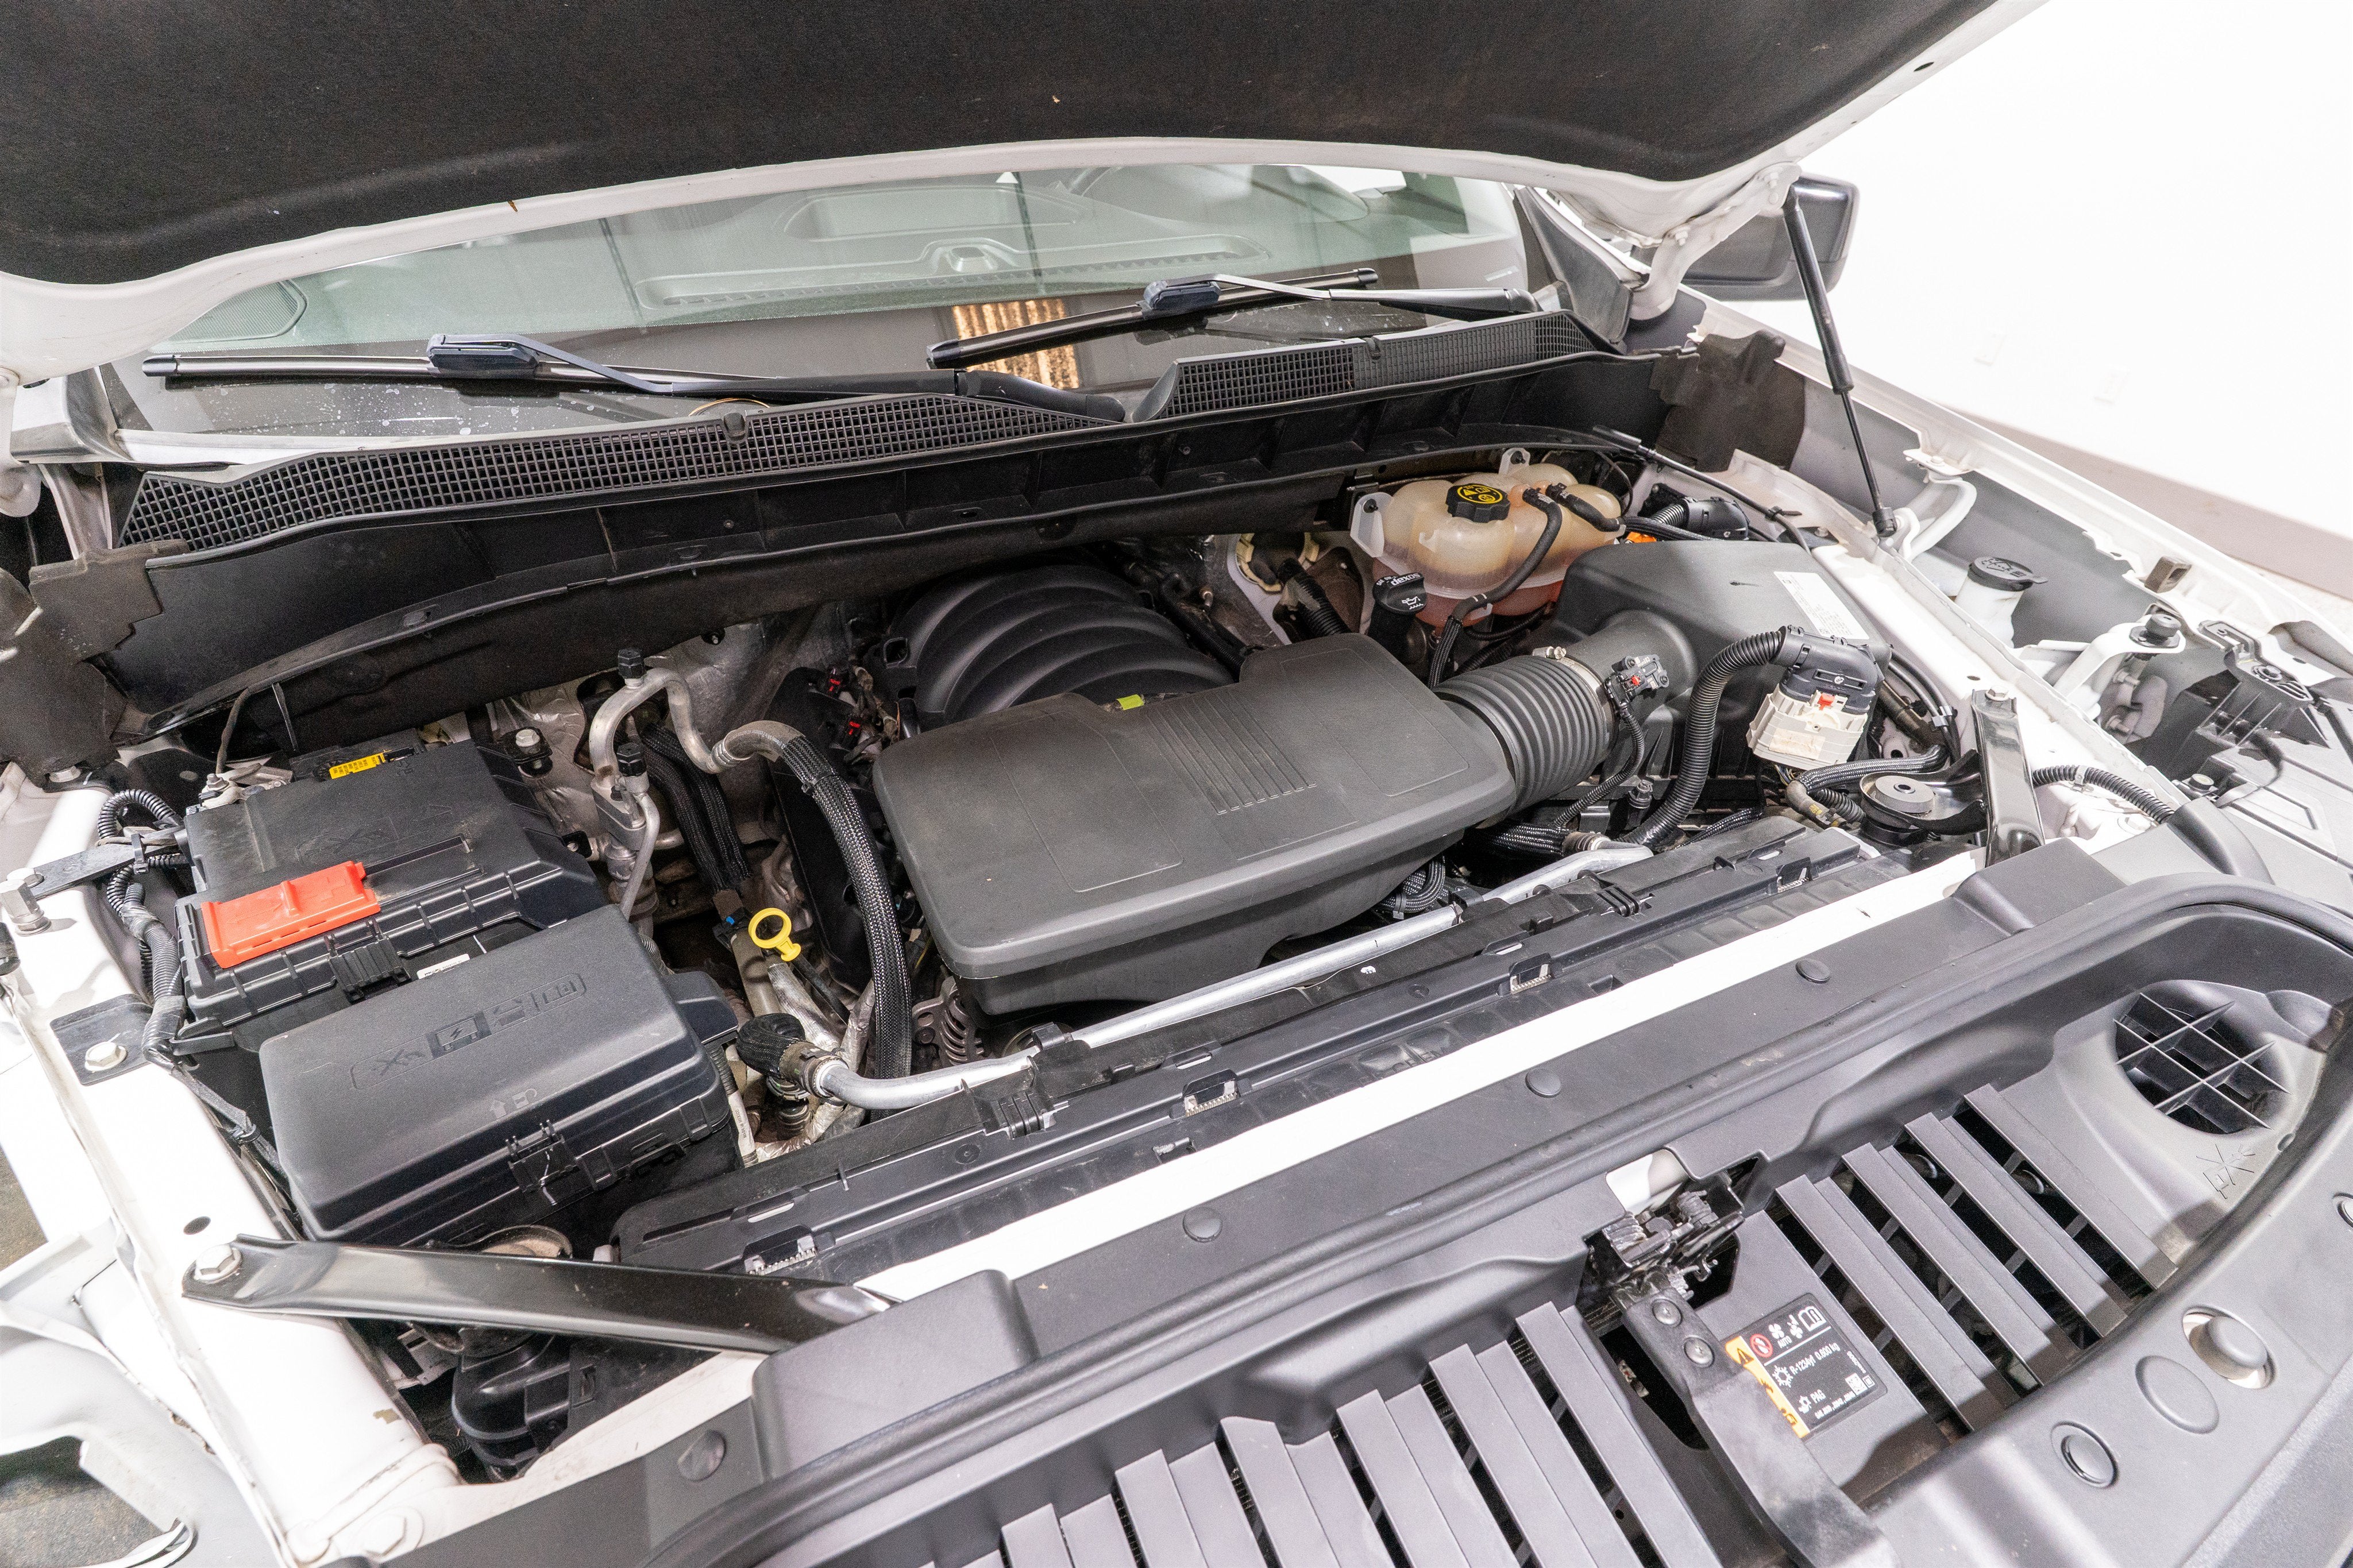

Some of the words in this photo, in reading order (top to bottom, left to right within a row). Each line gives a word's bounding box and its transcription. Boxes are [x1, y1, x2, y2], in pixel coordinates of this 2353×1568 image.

[1390, 573, 1421, 586] dexos
[1777, 1337, 1792, 1349] AUTO
[1789, 1354, 1816, 1375] R-1234yf
[1829, 1342, 1841, 1352] kg
[1810, 1389, 1827, 1404] PAG
